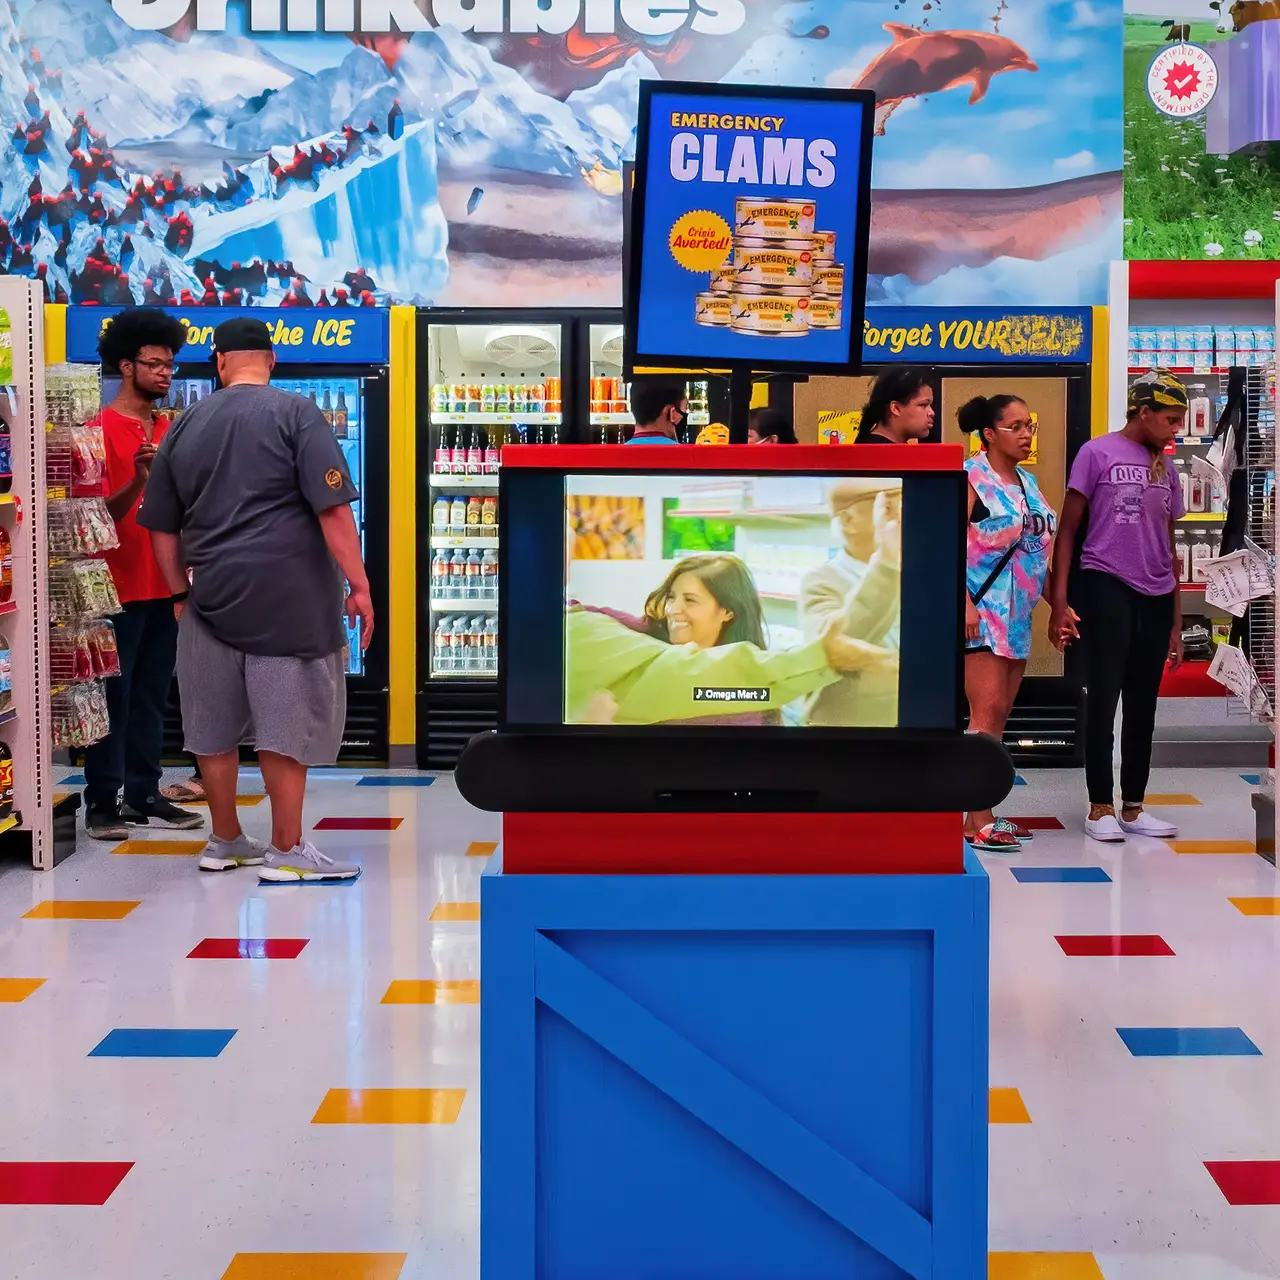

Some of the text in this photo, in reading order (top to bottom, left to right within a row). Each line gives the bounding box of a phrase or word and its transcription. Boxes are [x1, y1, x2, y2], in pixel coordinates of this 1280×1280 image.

[1152, 47, 1214, 113] CERTIFIED BY THE DEPARTMENT
[671, 113, 784, 131] EMERGENCY
[670, 132, 836, 187] CLAMS
[673, 236, 730, 251] Averted!
[687, 227, 716, 238] Crisis
[312, 319, 356, 346] ICE
[864, 319, 933, 354] forget
[705, 688, 758, 701] Omega Mart
